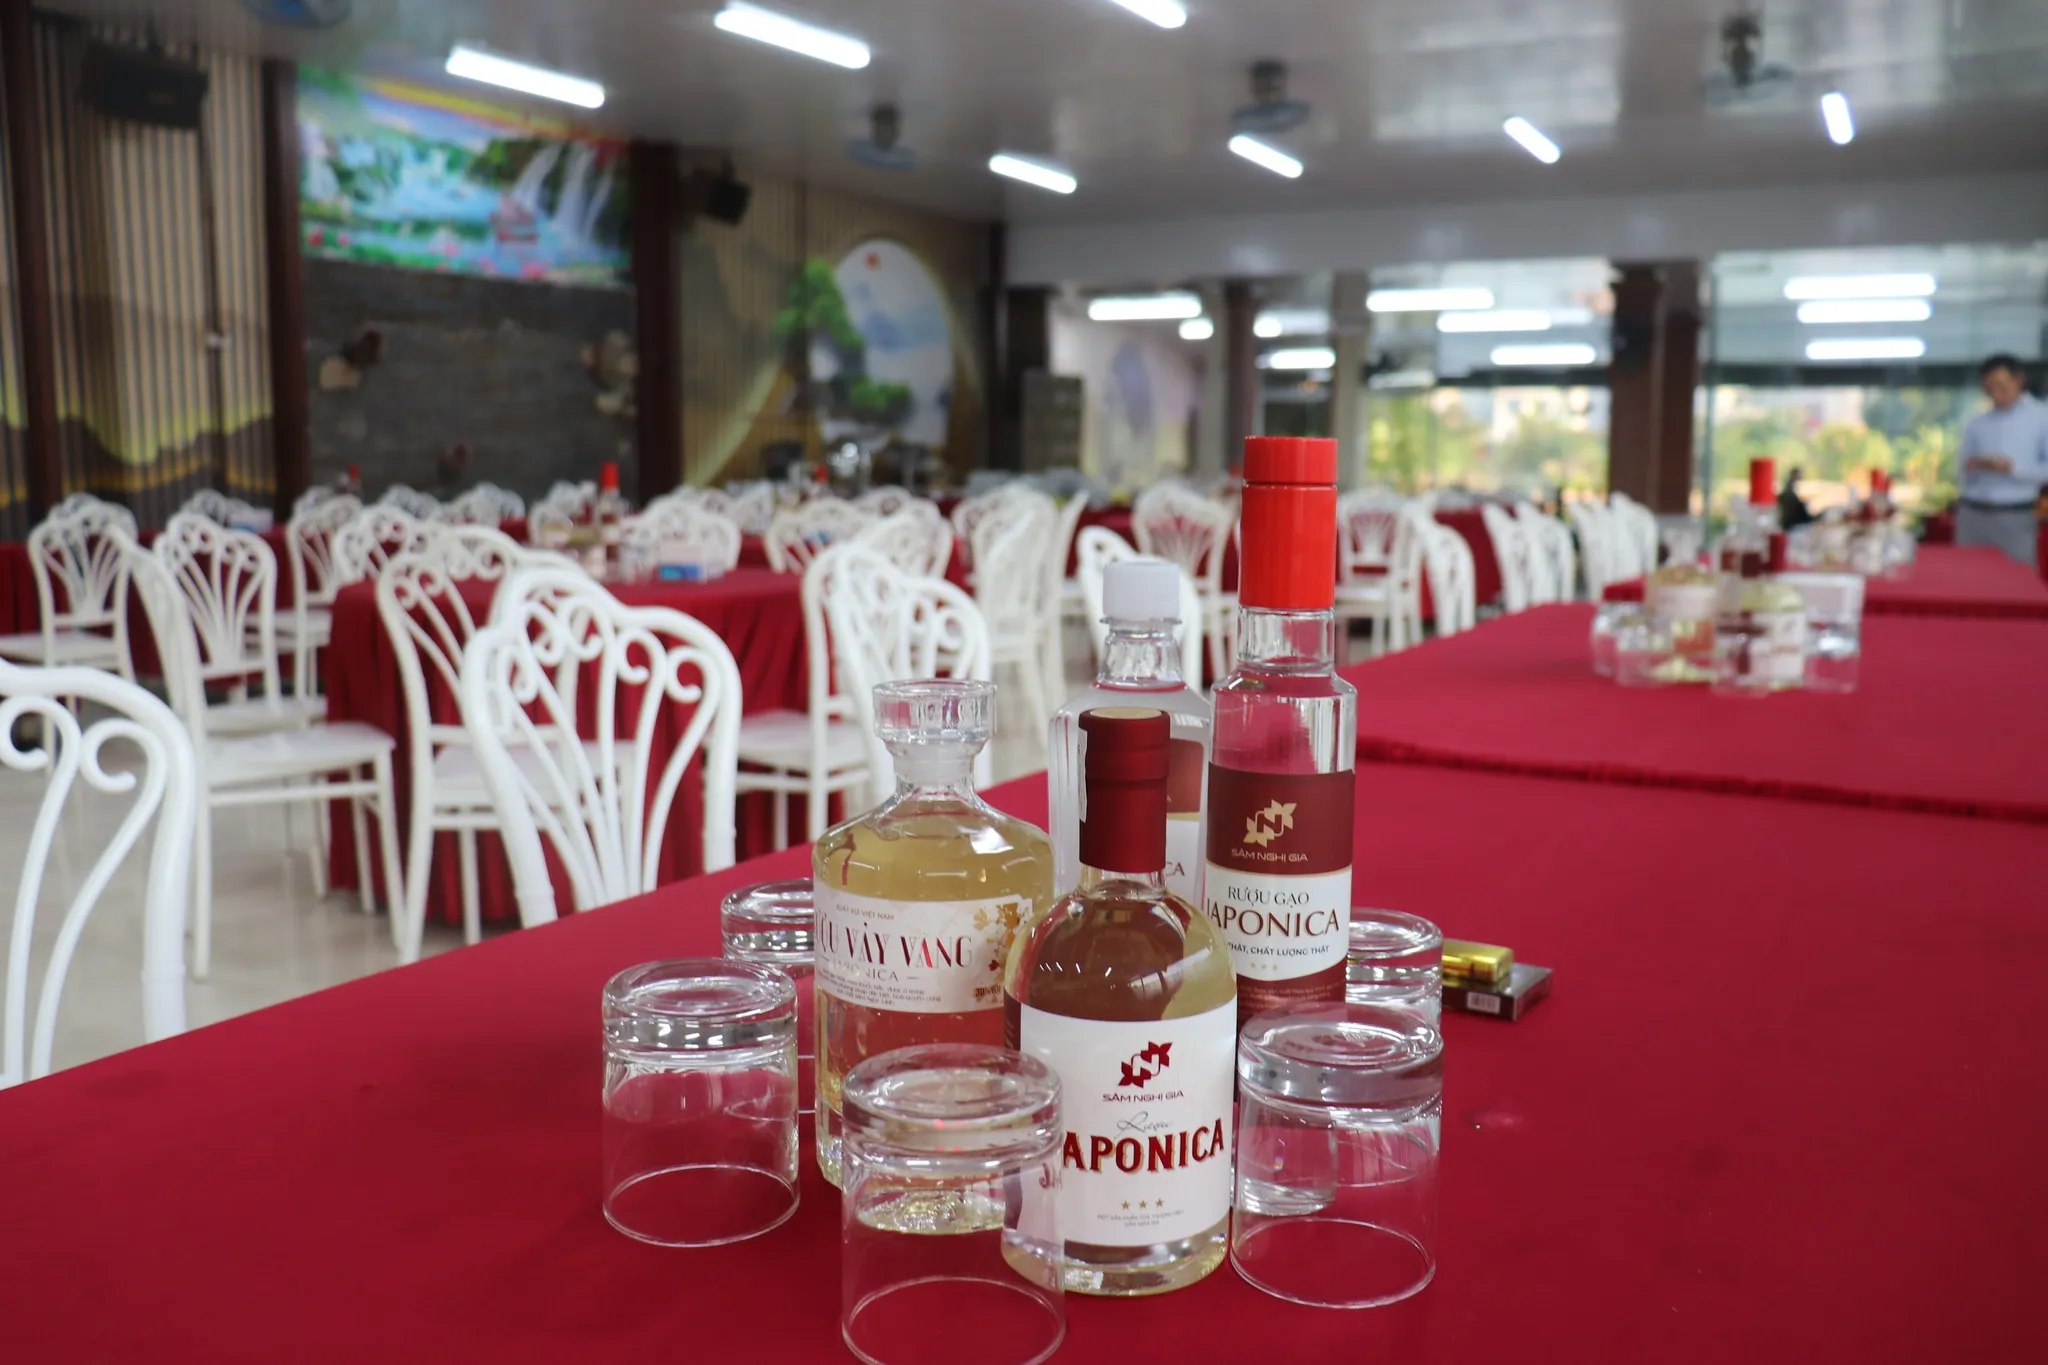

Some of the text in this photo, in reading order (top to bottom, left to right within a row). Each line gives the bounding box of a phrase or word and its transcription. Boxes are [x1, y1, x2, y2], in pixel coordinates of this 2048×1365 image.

[1288, 852, 1309, 862] GIA
[1228, 885, 1310, 908] RƯỢU GẠO
[1165, 1089, 1184, 1100] GIA
